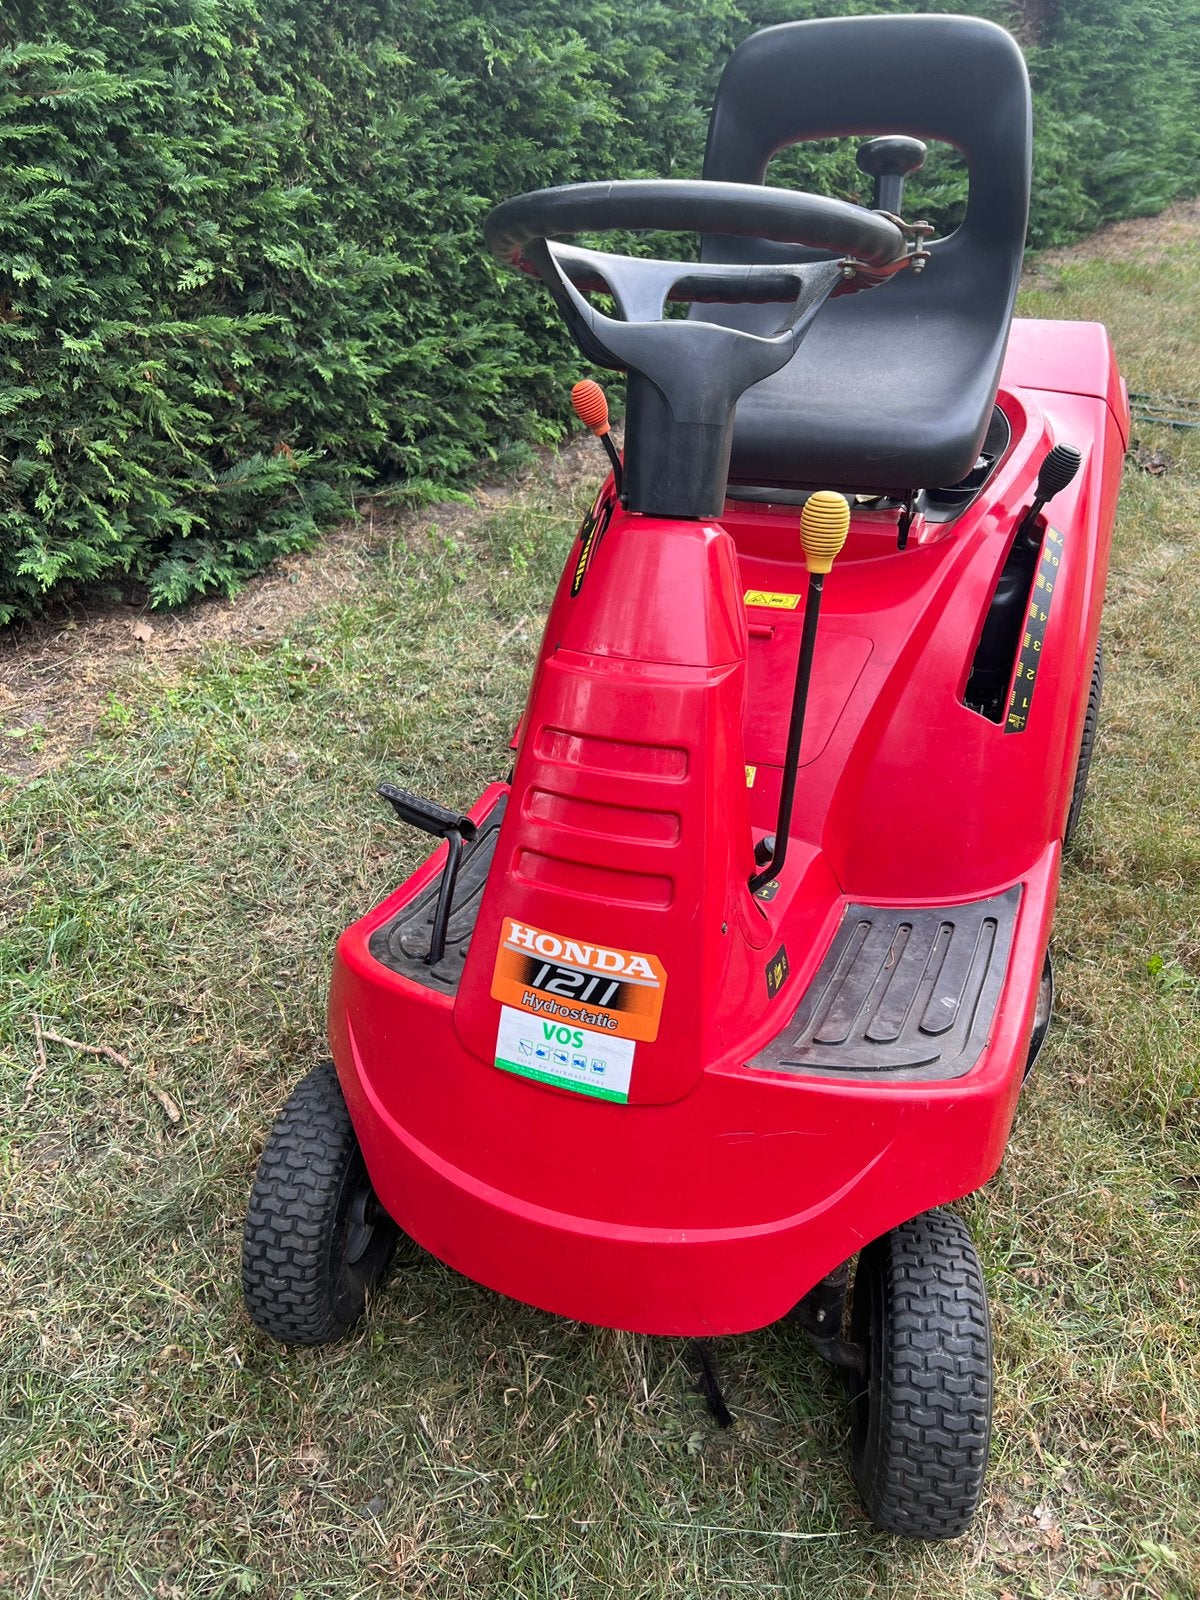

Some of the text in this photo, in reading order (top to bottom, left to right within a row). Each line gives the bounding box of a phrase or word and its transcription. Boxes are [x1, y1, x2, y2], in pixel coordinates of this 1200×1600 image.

[1052, 556, 1059, 567] 6
[1045, 582, 1053, 593] 5
[1039, 611, 1047, 621] 4
[1033, 640, 1041, 651] 3
[1026, 668, 1035, 680] 2
[1021, 697, 1028, 708] 1
[507, 922, 657, 979] HONDA
[532, 963, 620, 1006] 1211
[521, 991, 619, 1030] Hydrostatic
[541, 1021, 584, 1048] VOS
